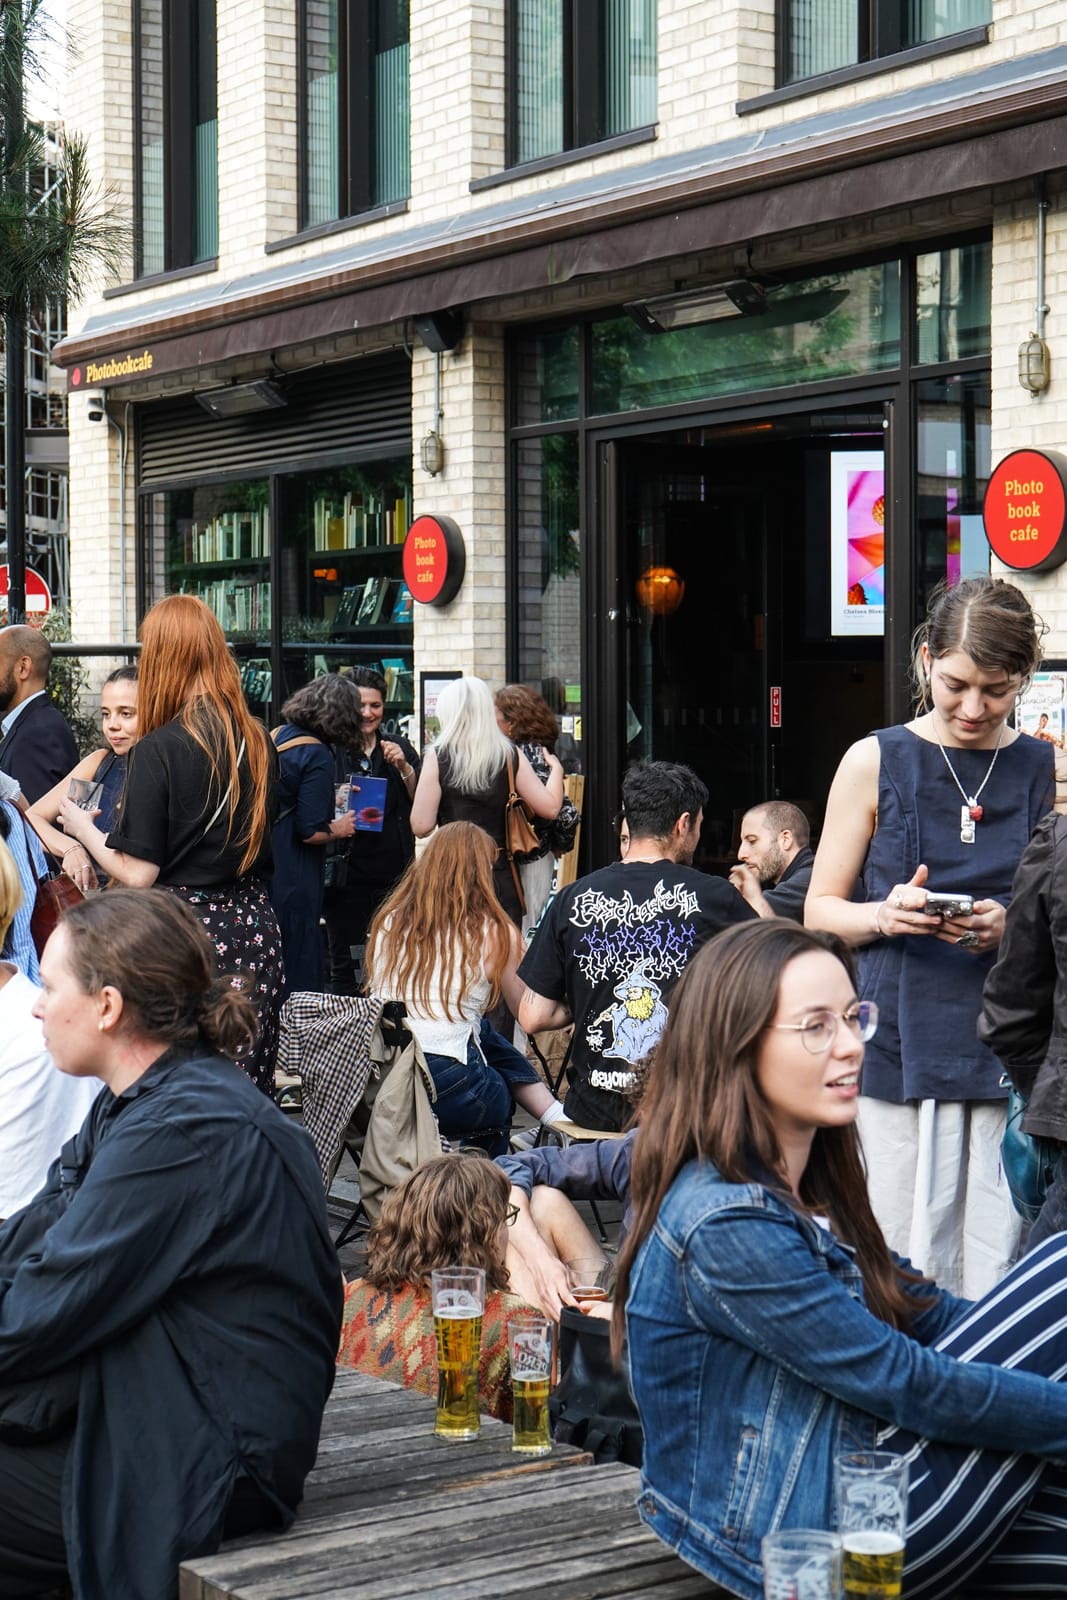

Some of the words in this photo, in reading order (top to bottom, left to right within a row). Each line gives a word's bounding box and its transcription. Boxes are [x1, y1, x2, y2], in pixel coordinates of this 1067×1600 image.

[86, 350, 153, 383] Photobookcafe
[1005, 480, 1043, 496] Photo
[1008, 501, 1040, 519] book
[1010, 524, 1039, 541] cafe
[414, 537, 436, 549] Photo
[416, 553, 434, 566] book
[417, 570, 433, 582] cafe
